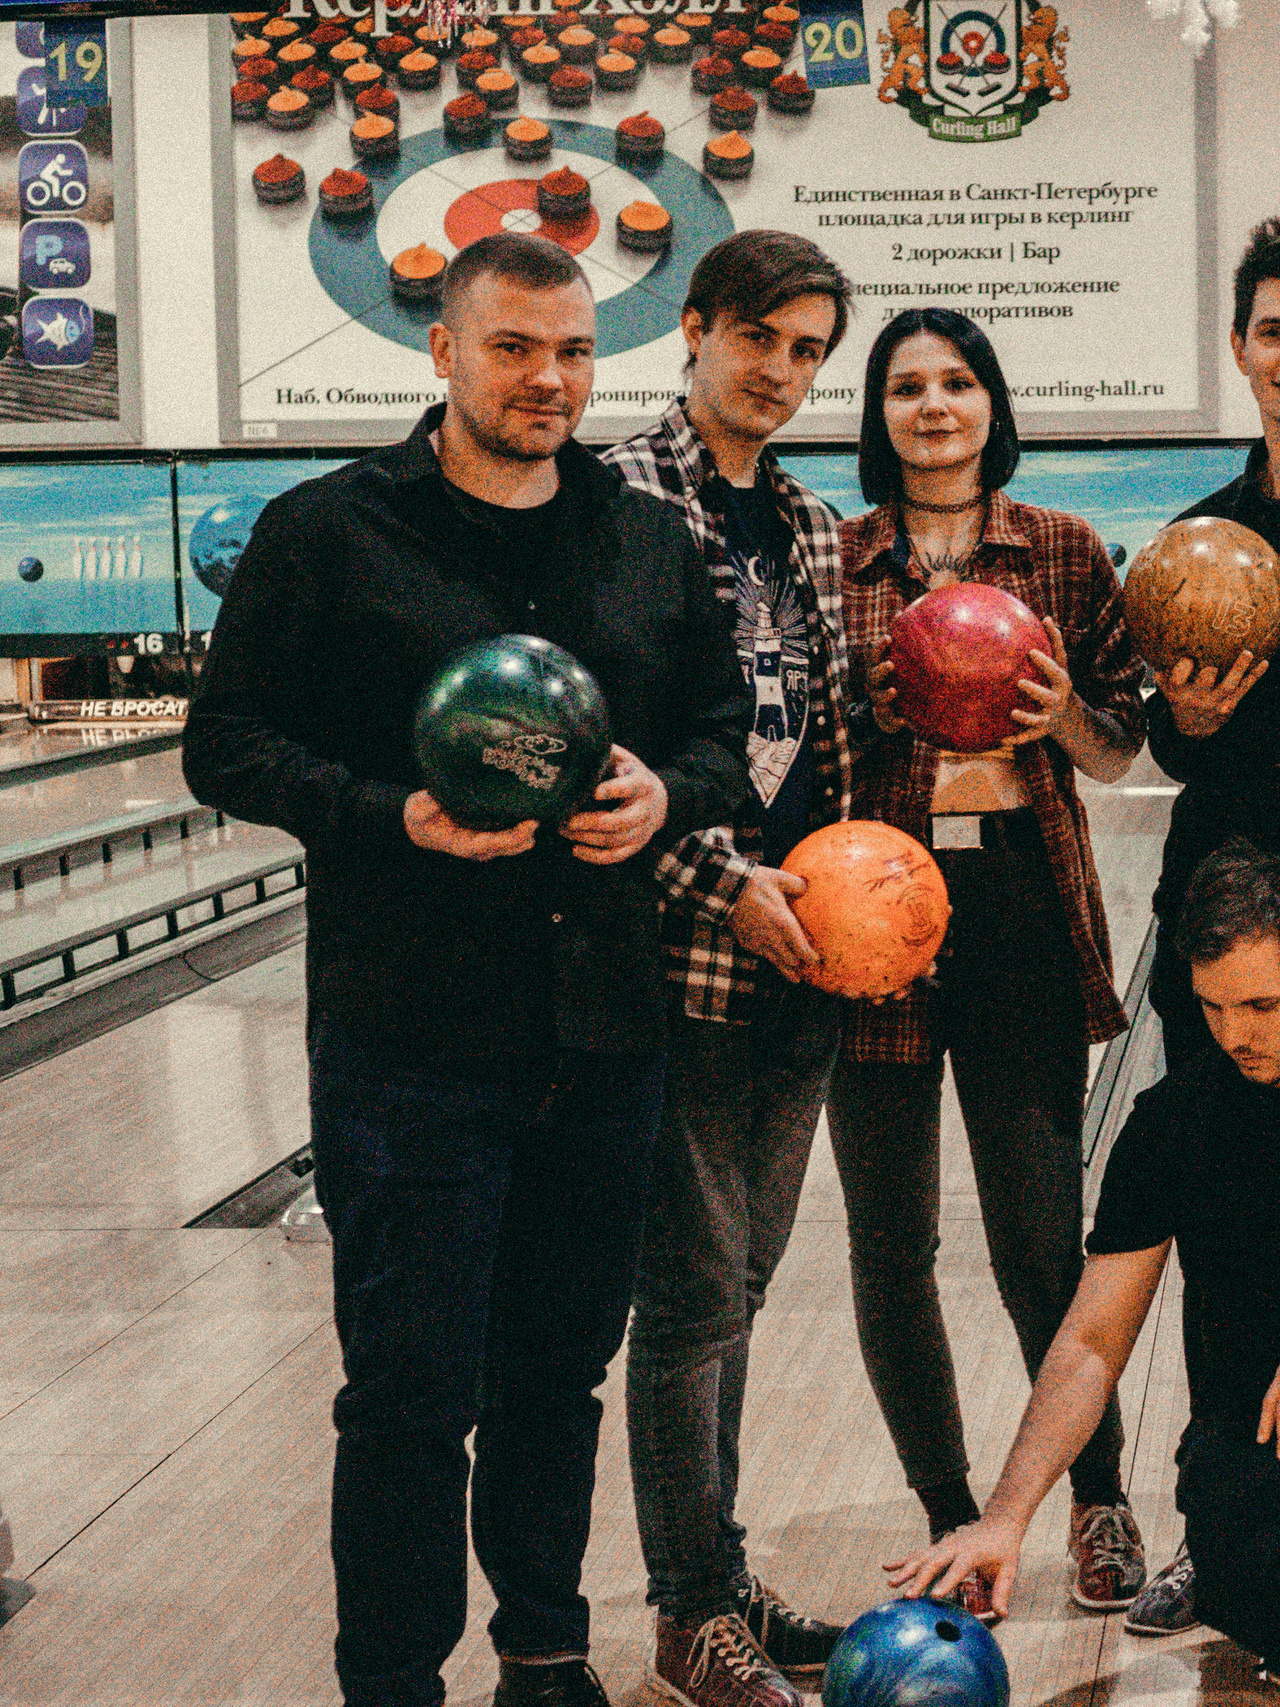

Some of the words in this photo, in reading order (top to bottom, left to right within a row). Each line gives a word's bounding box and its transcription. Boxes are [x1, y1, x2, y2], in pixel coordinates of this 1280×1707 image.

[805, 19, 864, 62] 20
[49, 41, 103, 82] 19
[932, 117, 985, 140] Curling
[987, 116, 1018, 136] Hall
[794, 184, 944, 205] Единственная
[949, 189, 961, 201] в
[965, 181, 1159, 206] Санкт-Петербурге
[818, 213, 923, 228] площадка
[926, 212, 966, 228] для
[970, 211, 1025, 231] игры
[1030, 211, 1042, 224] в
[1046, 209, 1134, 230] керлинг
[892, 243, 903, 261] 2
[906, 247, 1002, 266] дорожки
[1022, 241, 1061, 265] Бар
[853, 281, 973, 298] пециальное
[977, 279, 1121, 301] предложение
[276, 388, 321, 404] Наб.
[326, 387, 437, 406] Обводного
[589, 388, 687, 407] ронирова
[1007, 380, 1165, 402] w.curling-hall.ru
[133, 633, 164, 654] 16
[80, 701, 107, 717] НЕ
[111, 701, 189, 716] БРОСАТ
